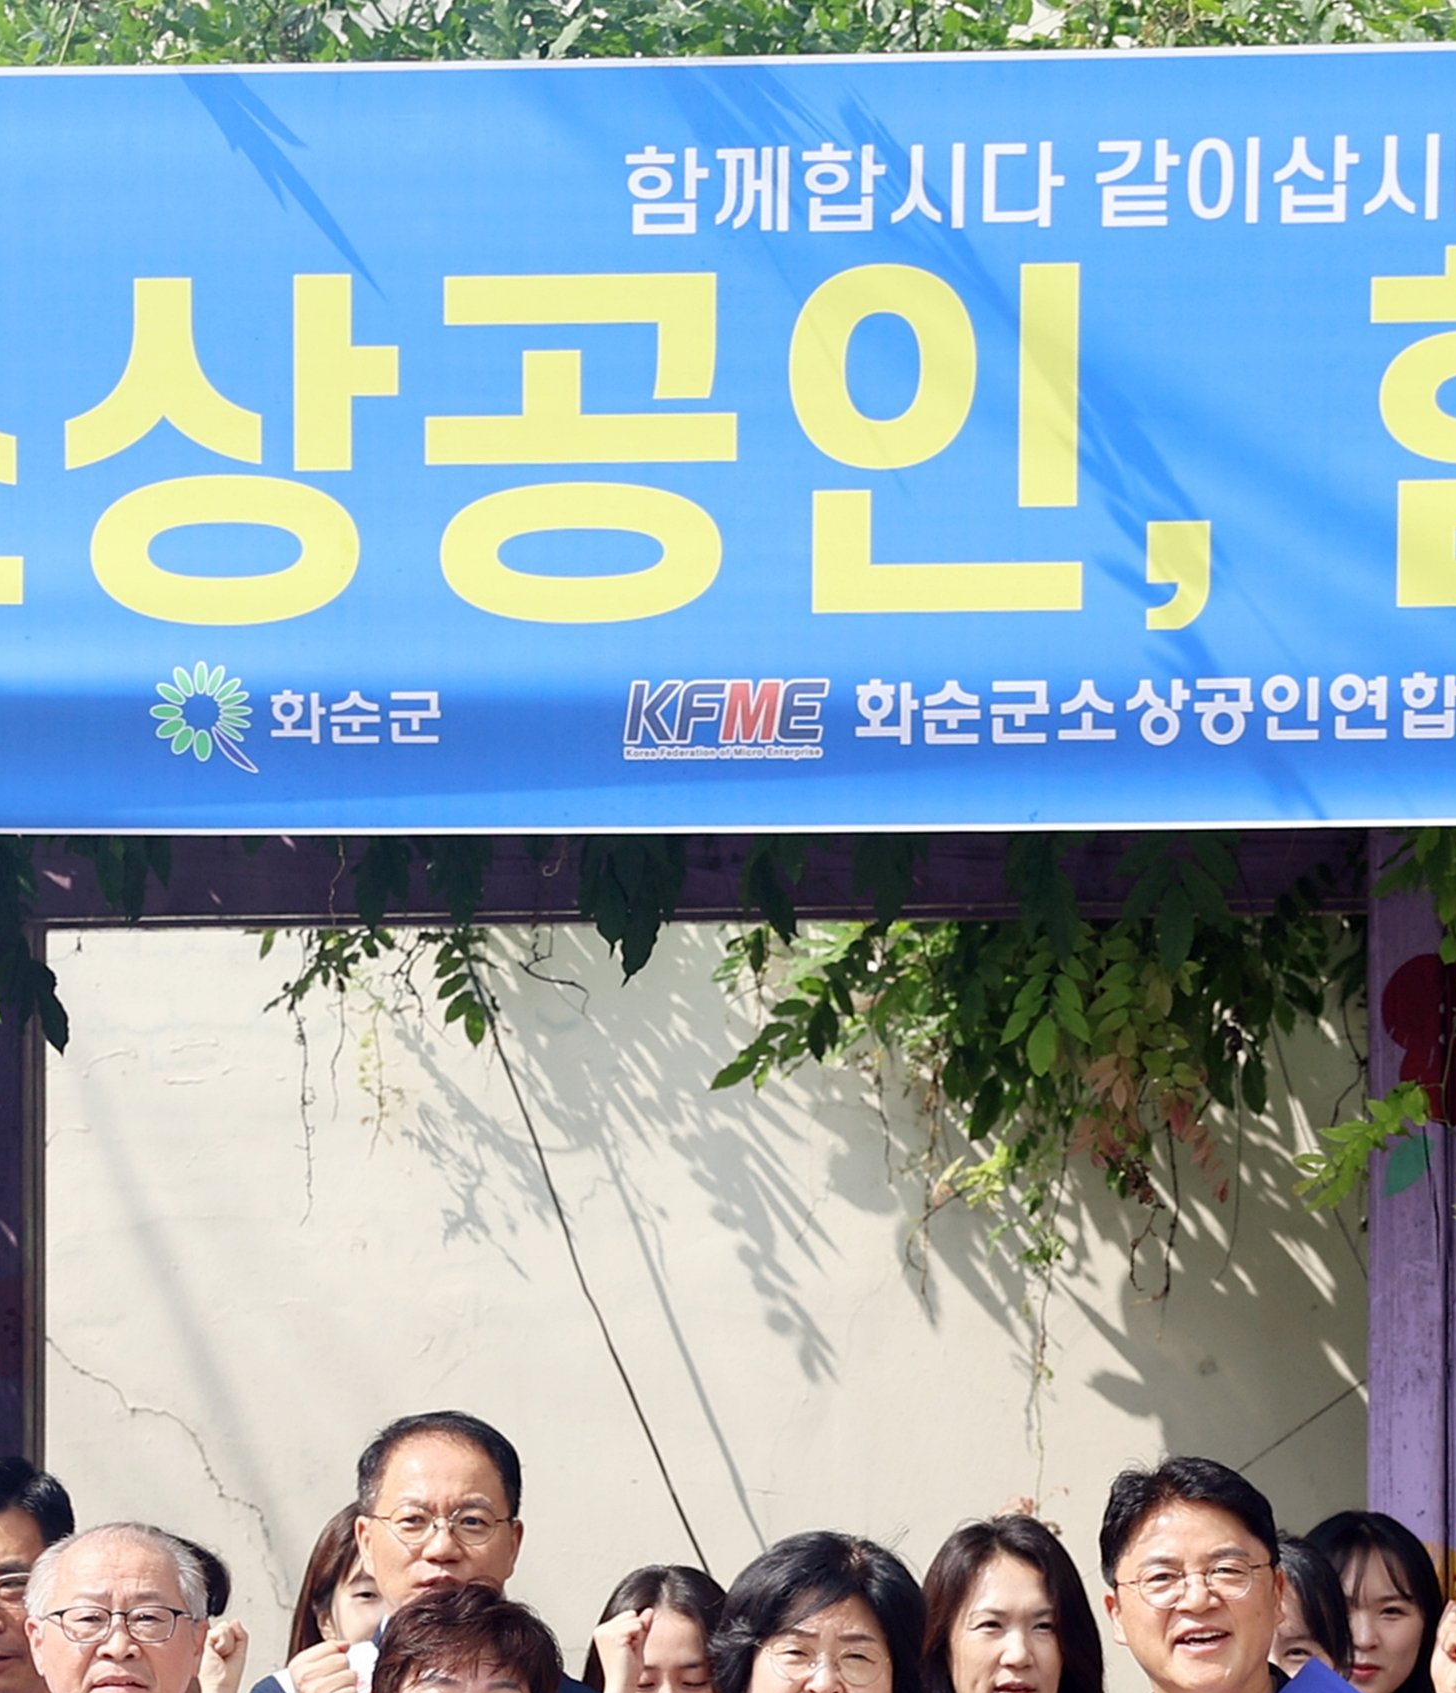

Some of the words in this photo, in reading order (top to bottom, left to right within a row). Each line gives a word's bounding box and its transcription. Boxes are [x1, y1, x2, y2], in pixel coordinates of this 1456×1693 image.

[626, 142, 1064, 236] 함께합시다
[270, 689, 441, 744] 화순군
[624, 679, 829, 743] KFME
